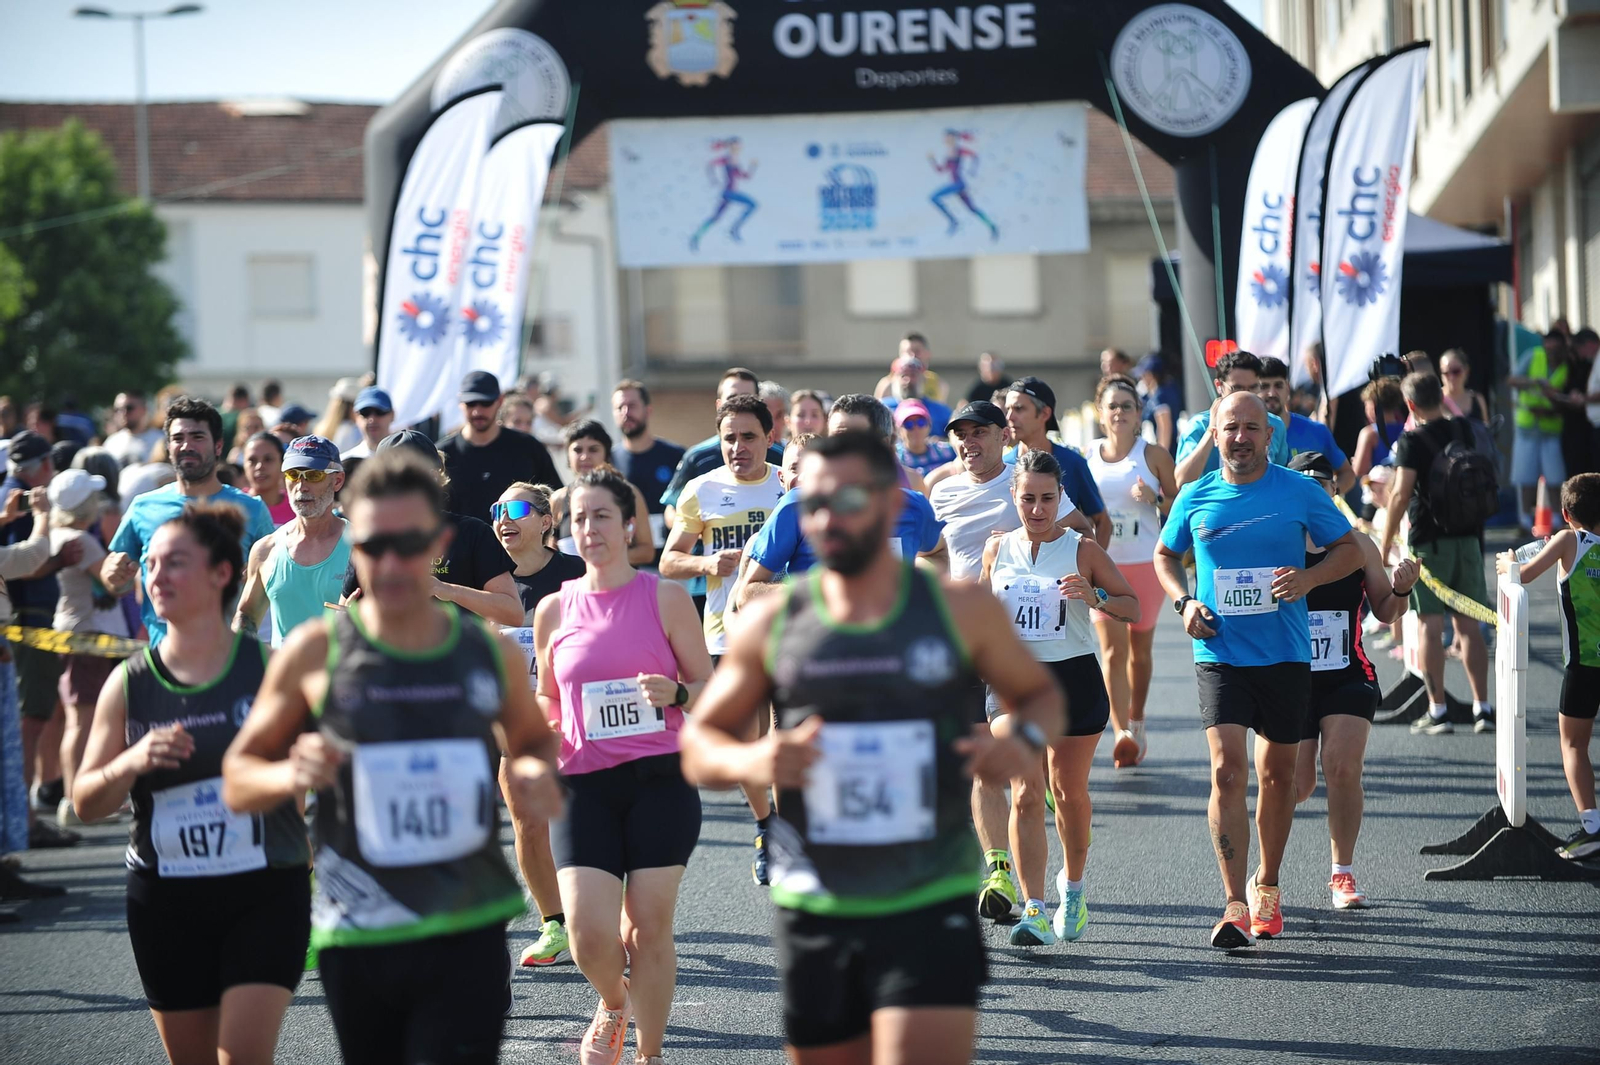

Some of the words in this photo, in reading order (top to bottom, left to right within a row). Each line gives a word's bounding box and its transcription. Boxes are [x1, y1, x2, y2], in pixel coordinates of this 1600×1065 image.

[773, 3, 1037, 58] OURENSE
[855, 67, 959, 90] Deportes
[1252, 192, 1282, 254] chc
[1338, 166, 1380, 241] chc
[402, 207, 446, 280] chc
[468, 221, 504, 288] chc
[748, 510, 765, 523] 59
[1014, 605, 1040, 629] 411
[1224, 588, 1262, 607] 4062
[600, 702, 640, 729] 1015
[604, 696, 631, 704] CRISTINA
[837, 778, 895, 821] 154
[179, 821, 227, 858] 197
[388, 796, 451, 844] 140
